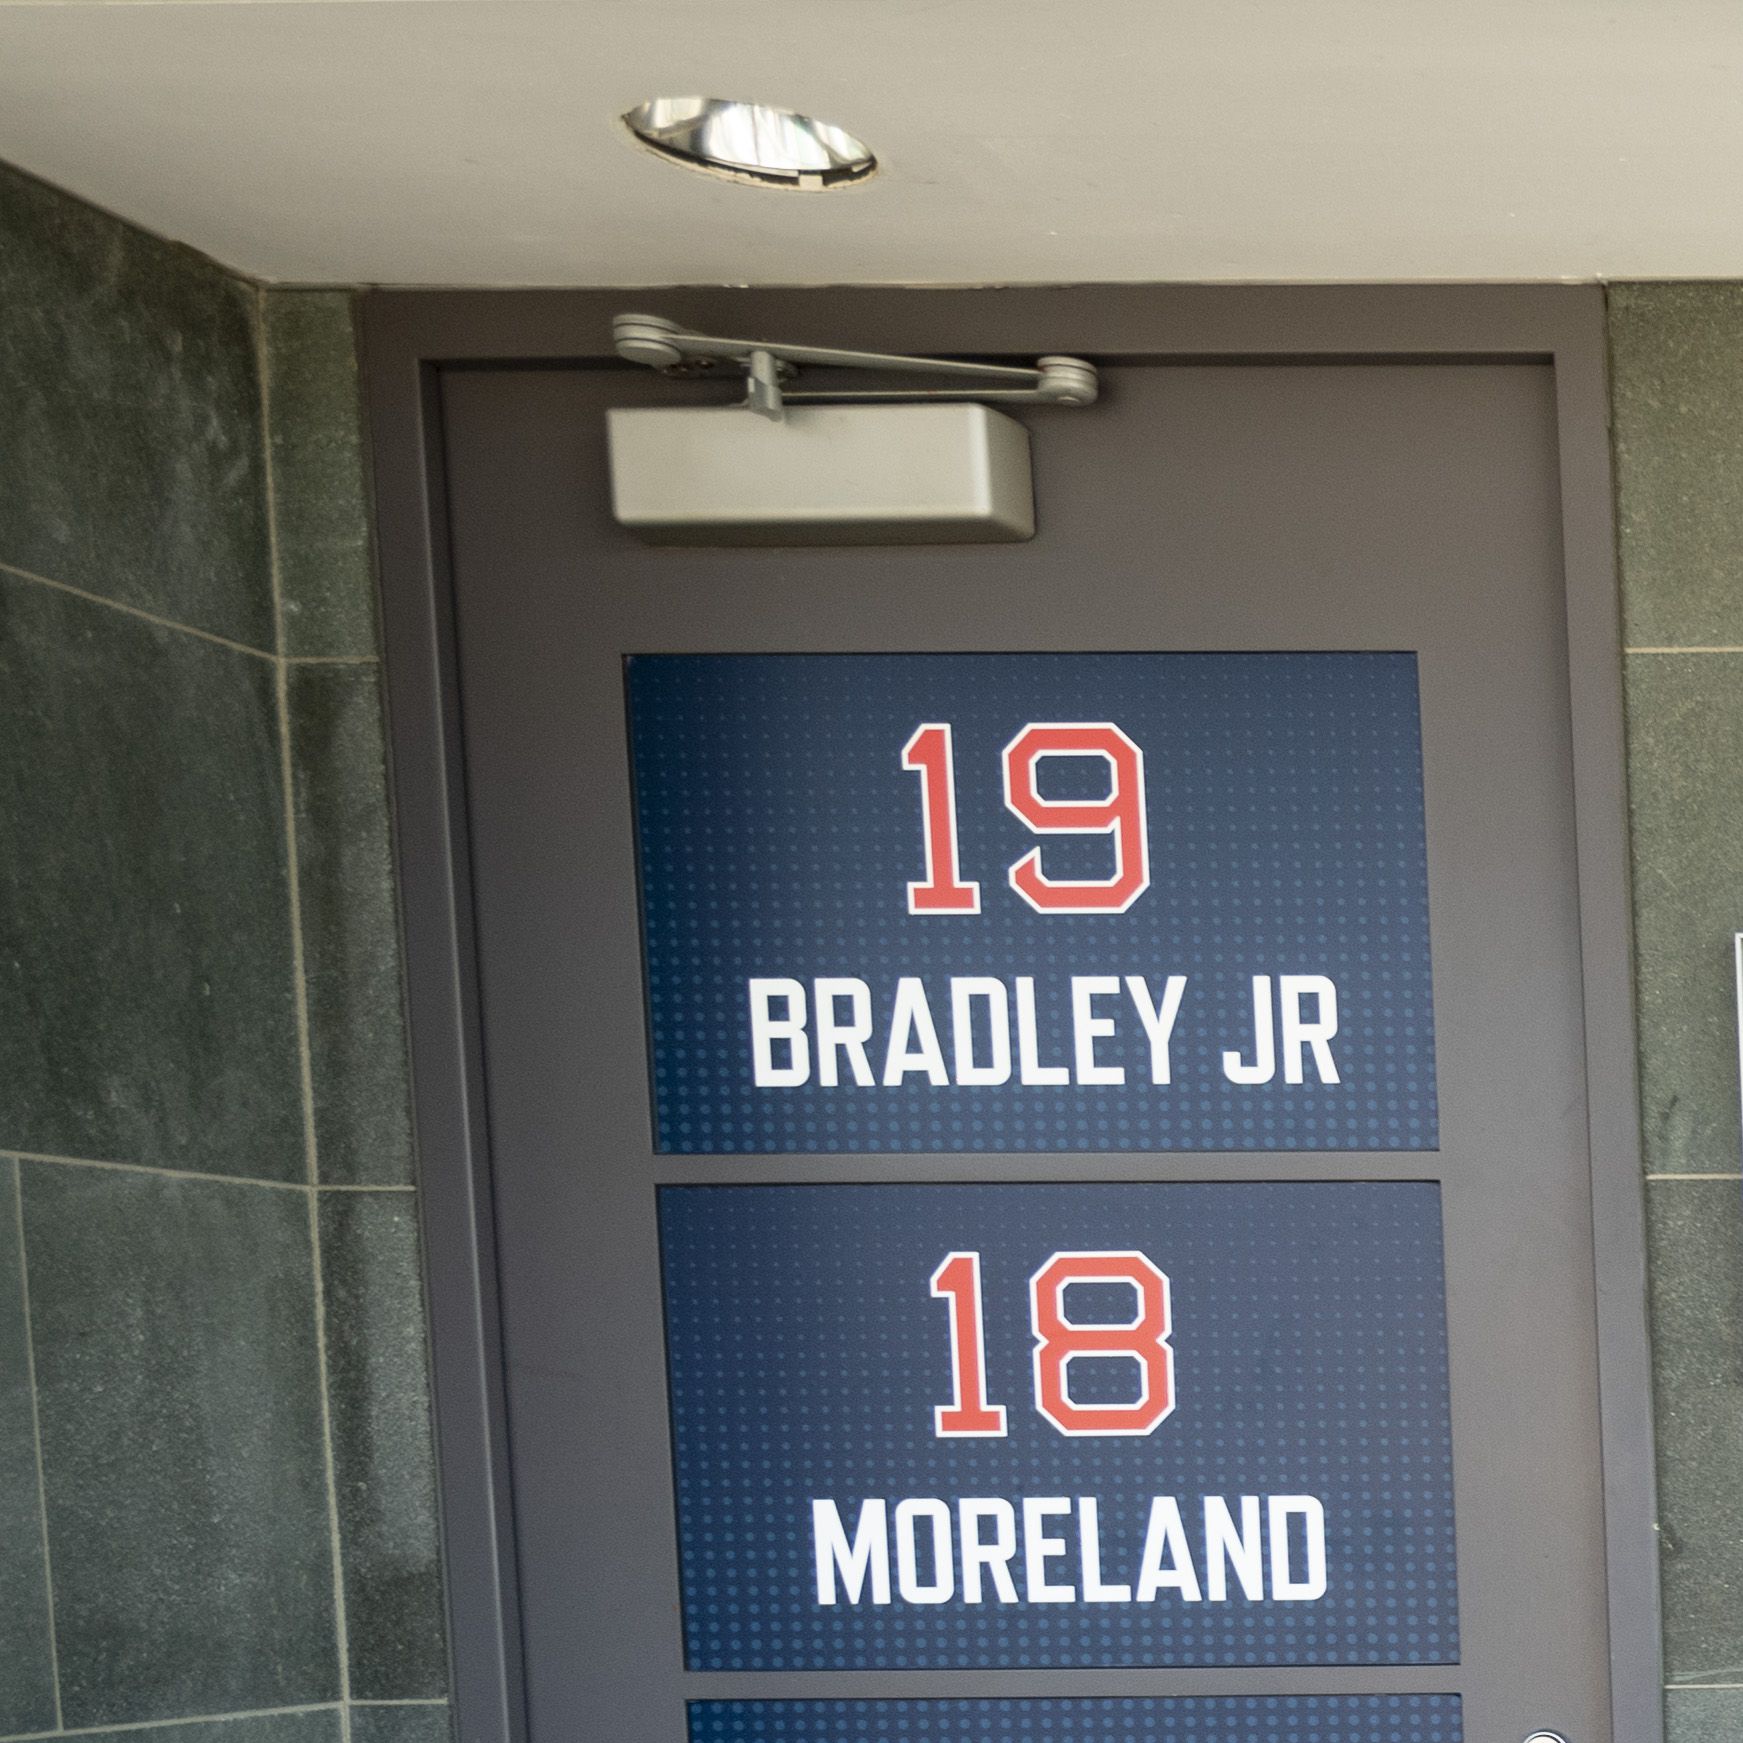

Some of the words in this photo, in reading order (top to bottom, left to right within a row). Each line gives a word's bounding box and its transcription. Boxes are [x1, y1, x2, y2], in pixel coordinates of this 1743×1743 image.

[901, 722, 1150, 915] 19
[749, 975, 1187, 1087] BRADLEY
[1222, 975, 1340, 1084] JR
[929, 1250, 1176, 1438] 18
[812, 1495, 1327, 1605] MORELAND
